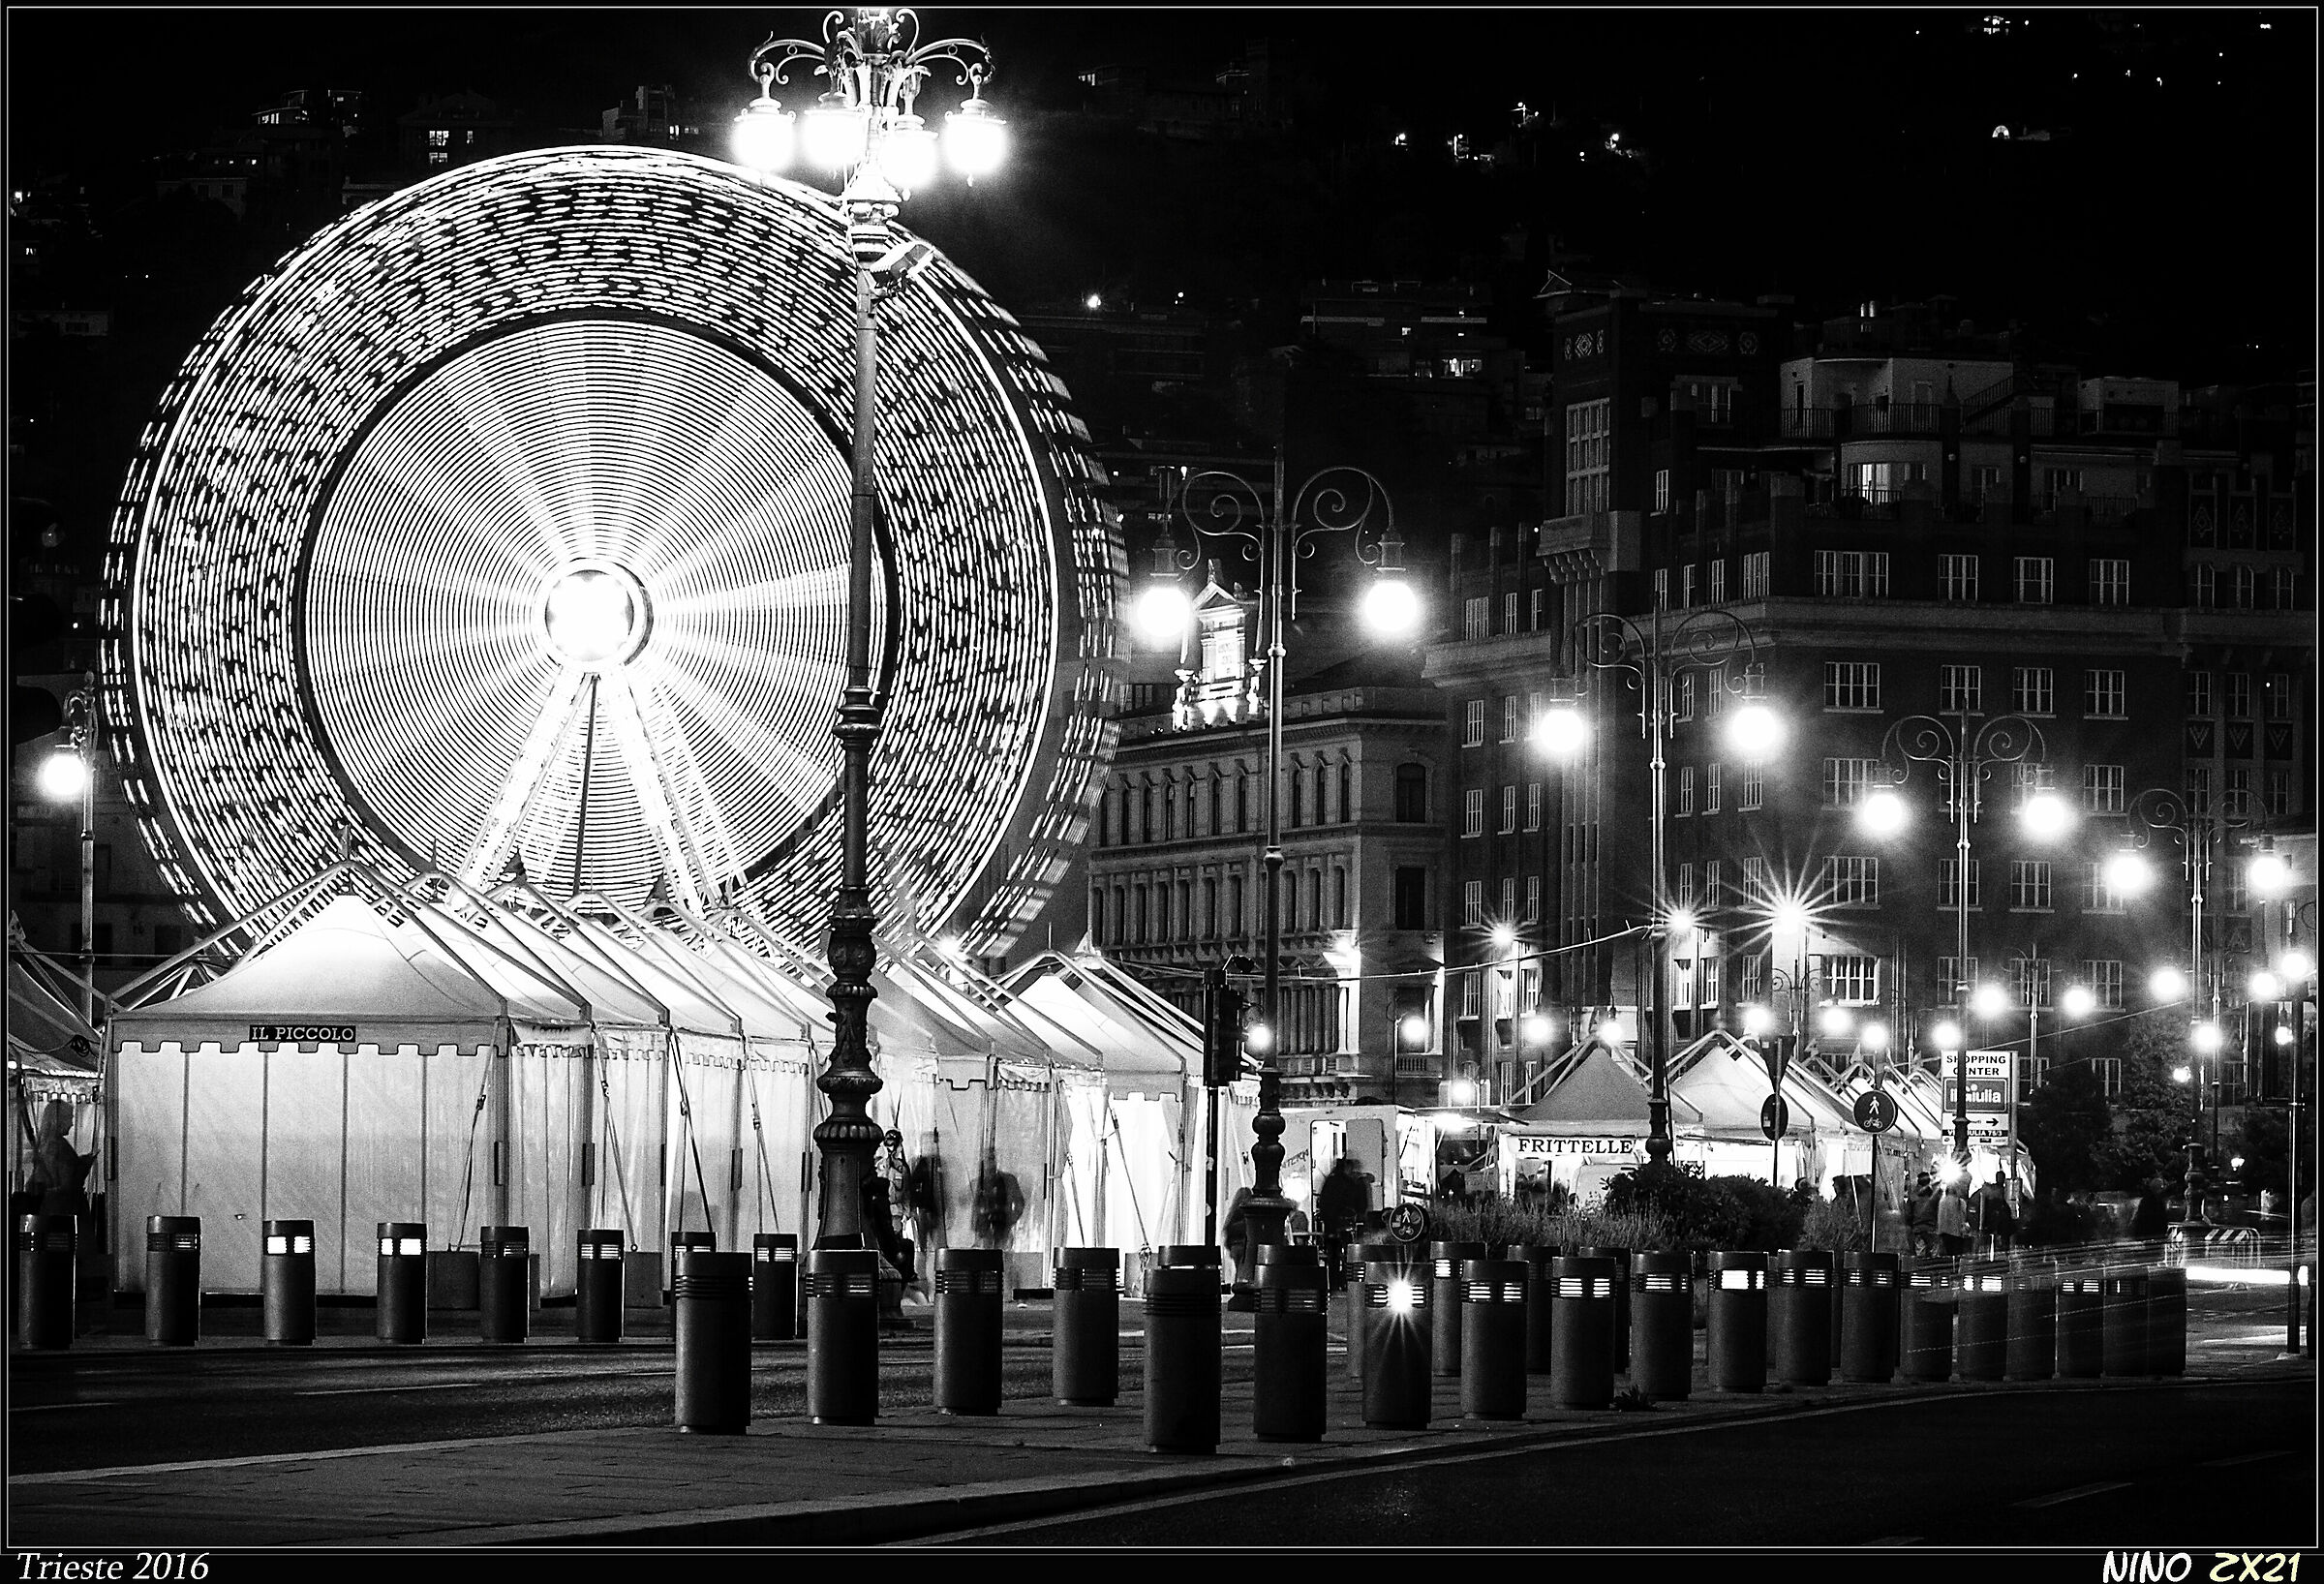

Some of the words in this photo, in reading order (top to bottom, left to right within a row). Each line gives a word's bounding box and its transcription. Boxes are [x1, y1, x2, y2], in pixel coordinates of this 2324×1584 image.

[252, 1026, 269, 1040] IL
[275, 1026, 354, 1041] PICCOLO
[1952, 1067, 2000, 1076] CNTER
[1517, 1138, 1634, 1154] FRITTELLE
